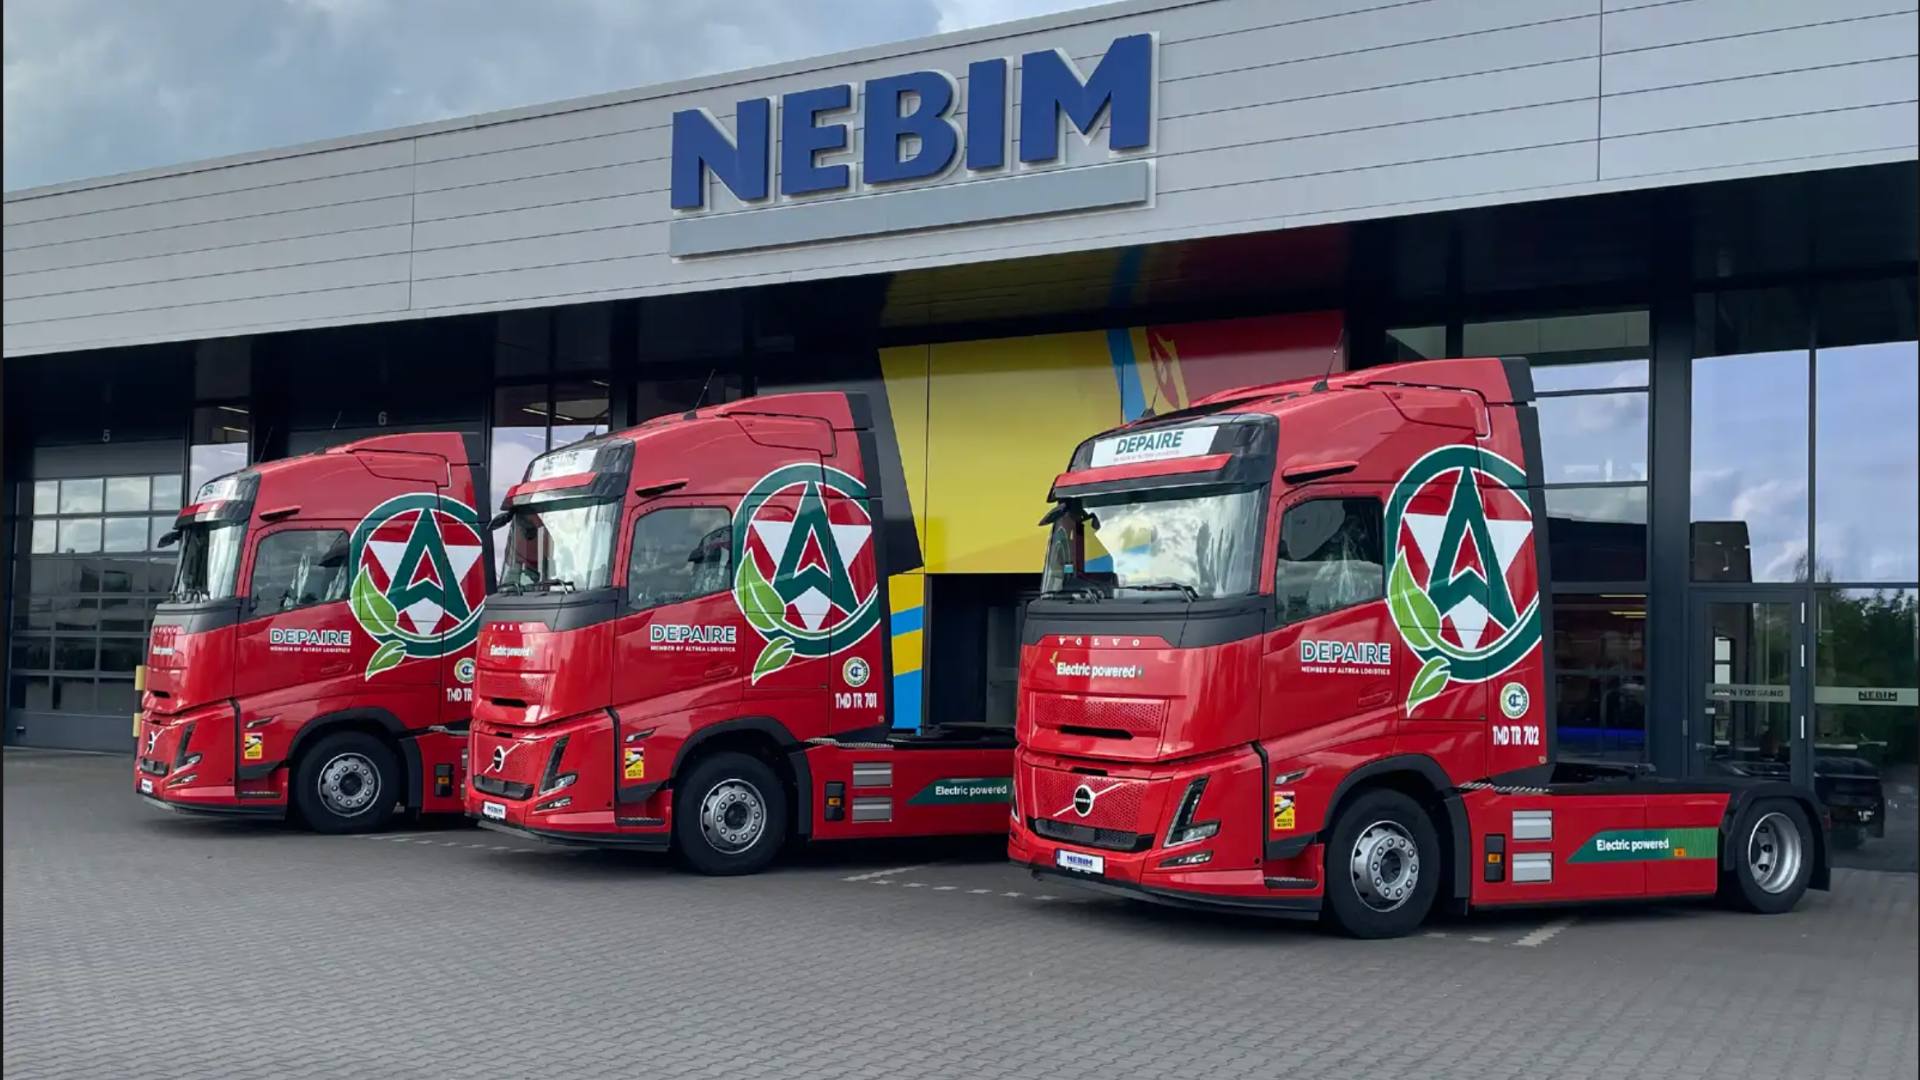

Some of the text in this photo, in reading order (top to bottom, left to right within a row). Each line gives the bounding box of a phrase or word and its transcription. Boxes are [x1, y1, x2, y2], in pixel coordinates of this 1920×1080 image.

[671, 33, 1152, 210] NEBIM
[378, 411, 388, 426] 6
[102, 429, 111, 442] 5
[1116, 431, 1184, 455] DEPAIRE
[270, 628, 352, 646] DEPAIRE
[650, 624, 736, 643] DEPAIRE
[1059, 638, 1140, 647] VOLVO
[1301, 640, 1391, 664] DEPAIRE
[1057, 662, 1137, 679] Electric powered
[1337, 667, 1359, 675] ALTREA
[1360, 668, 1391, 676] LOGISTICS
[446, 687, 462, 702] TMD
[835, 692, 877, 709] TMD TR 701
[1493, 725, 1540, 746] TMD TR 702
[935, 785, 1007, 797] Electric powered
[1596, 837, 1670, 853] Electric powered
